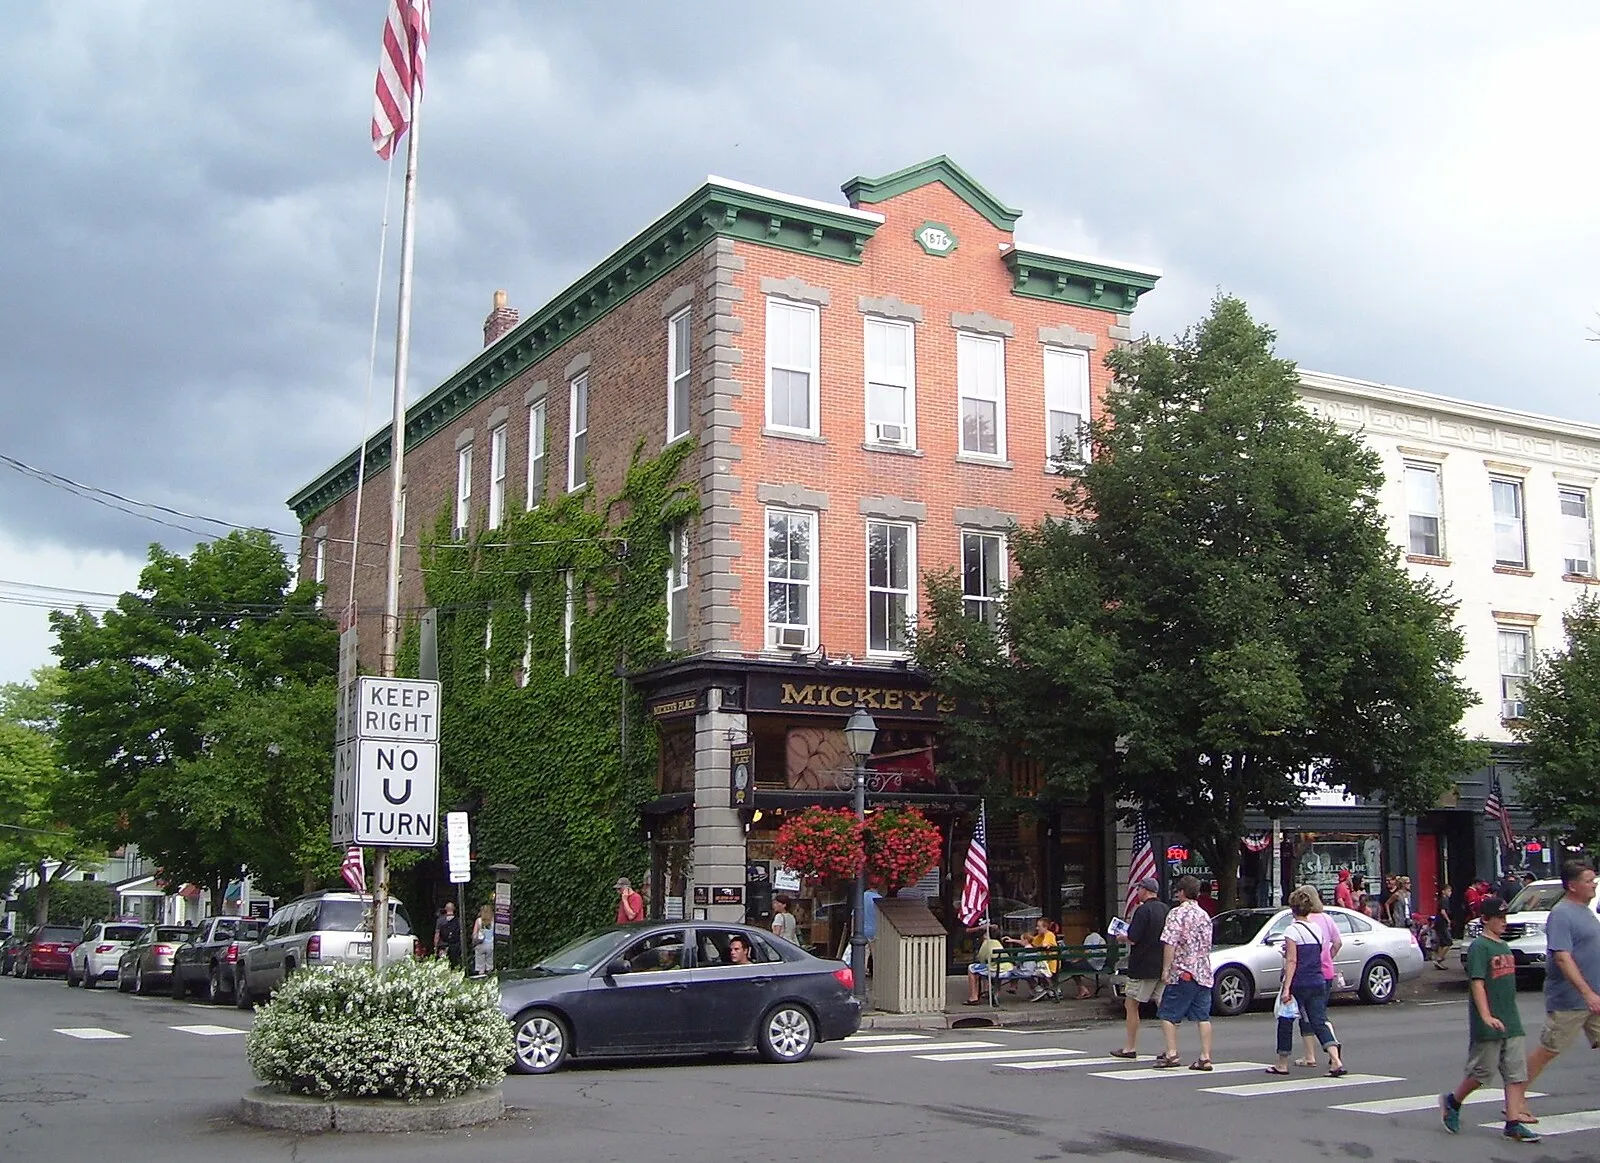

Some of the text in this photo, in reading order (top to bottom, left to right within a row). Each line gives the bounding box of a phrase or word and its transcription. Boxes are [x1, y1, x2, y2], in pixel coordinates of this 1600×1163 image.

[925, 232, 948, 246] 1876
[371, 687, 430, 708] KEEP
[366, 711, 432, 733] RIGHT
[377, 748, 418, 772] NO
[383, 778, 412, 805] U
[361, 811, 431, 836] TURN
[1172, 862, 1213, 877] SHOELE
